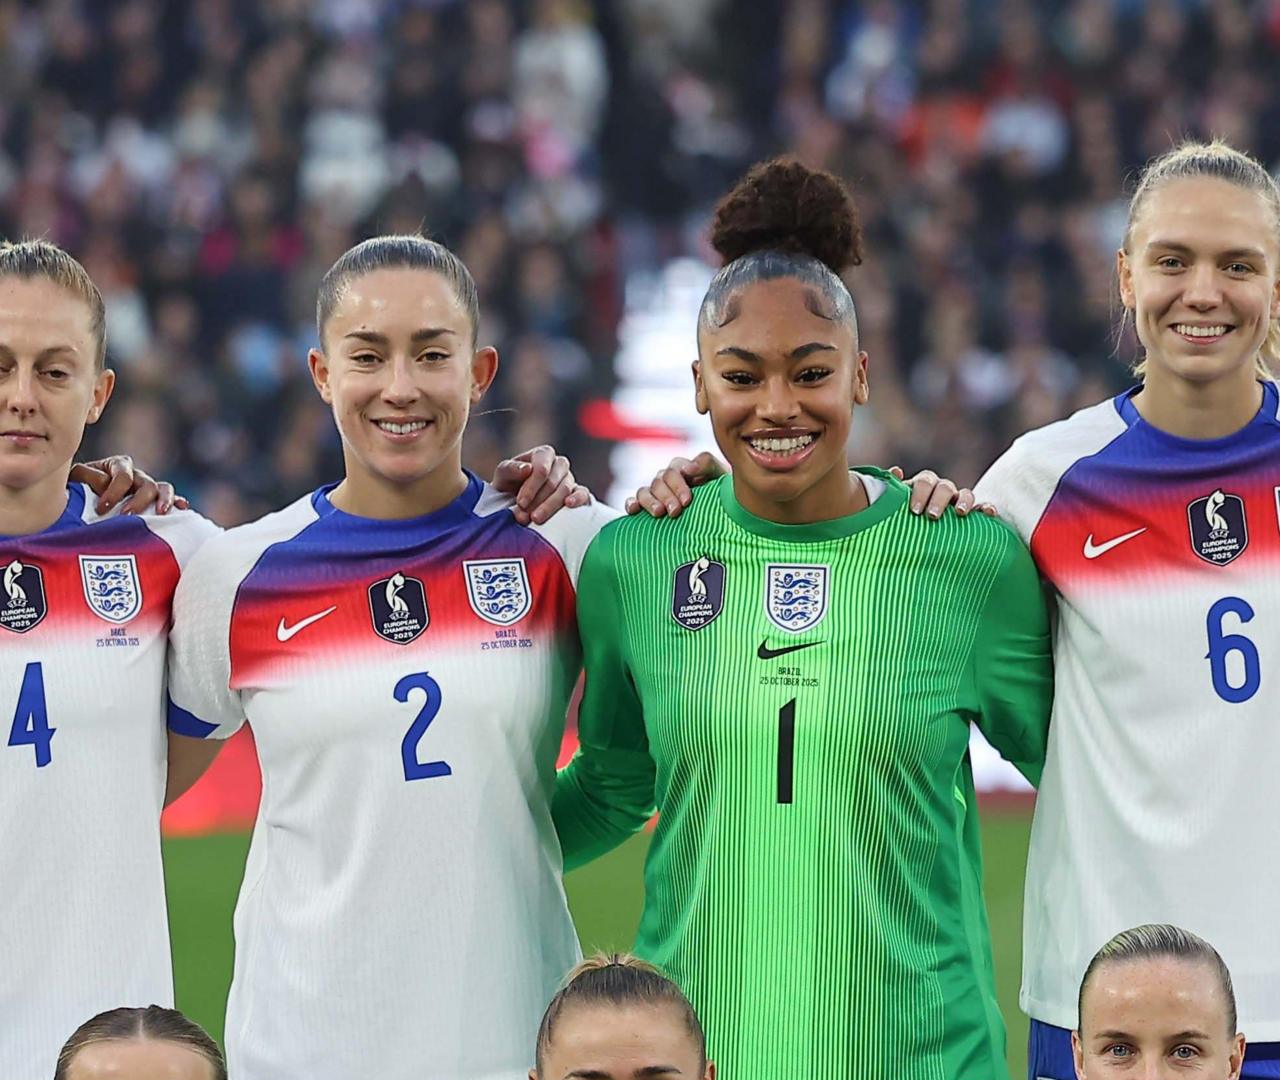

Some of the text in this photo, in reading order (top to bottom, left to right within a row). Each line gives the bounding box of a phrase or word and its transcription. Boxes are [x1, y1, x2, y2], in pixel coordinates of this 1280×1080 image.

[1202, 538, 1237, 548] EUROPEAN
[1202, 544, 1239, 554] CHAMPIONS
[1212, 552, 1232, 560] 2025
[1, 608, 35, 616] EUROPEAN
[680, 604, 712, 612] EUROPEAN
[0, 612, 38, 622] CHAMPIONS
[678, 610, 713, 618] CHAMPIONS
[11, 620, 30, 628] 2025
[384, 619, 418, 628] EUROPEAN
[383, 624, 420, 634] CHAMPIONS
[394, 631, 413, 640] 2025
[1205, 596, 1261, 704] 6
[760, 677, 769, 685] 25
[770, 677, 799, 686] OCTOBER
[7, 661, 56, 768] 4
[393, 671, 452, 782] 2
[777, 698, 796, 804] 1
